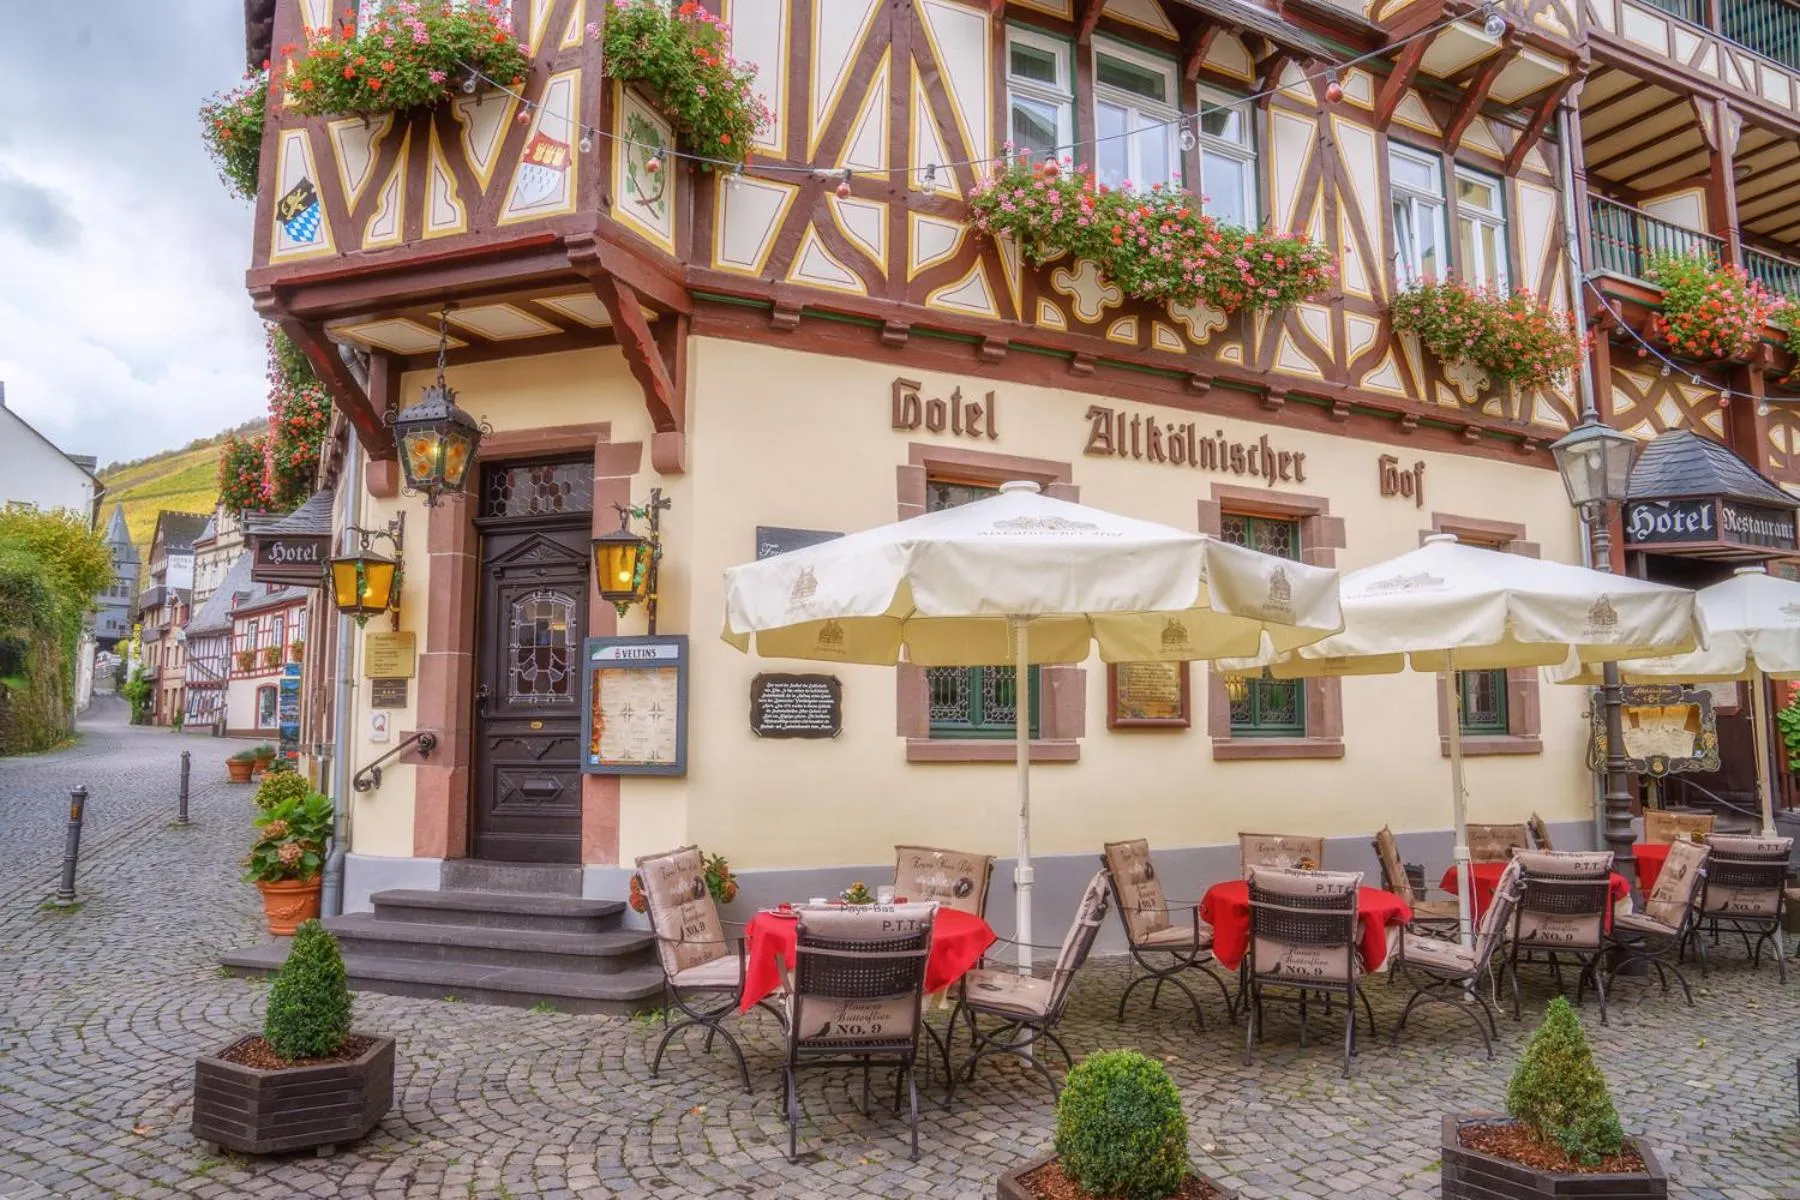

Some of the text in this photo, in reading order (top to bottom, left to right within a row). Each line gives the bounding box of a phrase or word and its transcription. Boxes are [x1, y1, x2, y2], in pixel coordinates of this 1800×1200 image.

[892, 377, 1426, 509] Hotel Altkölnischer Hof
[1626, 503, 1713, 540] Hotel
[1722, 507, 1794, 539] Restaurant
[268, 541, 319, 565] Hotel
[622, 648, 657, 658] VELTINS
[840, 904, 895, 916] Pays-Bas
[1286, 965, 1323, 976] NO. 9
[836, 1023, 882, 1035] NO. 9
